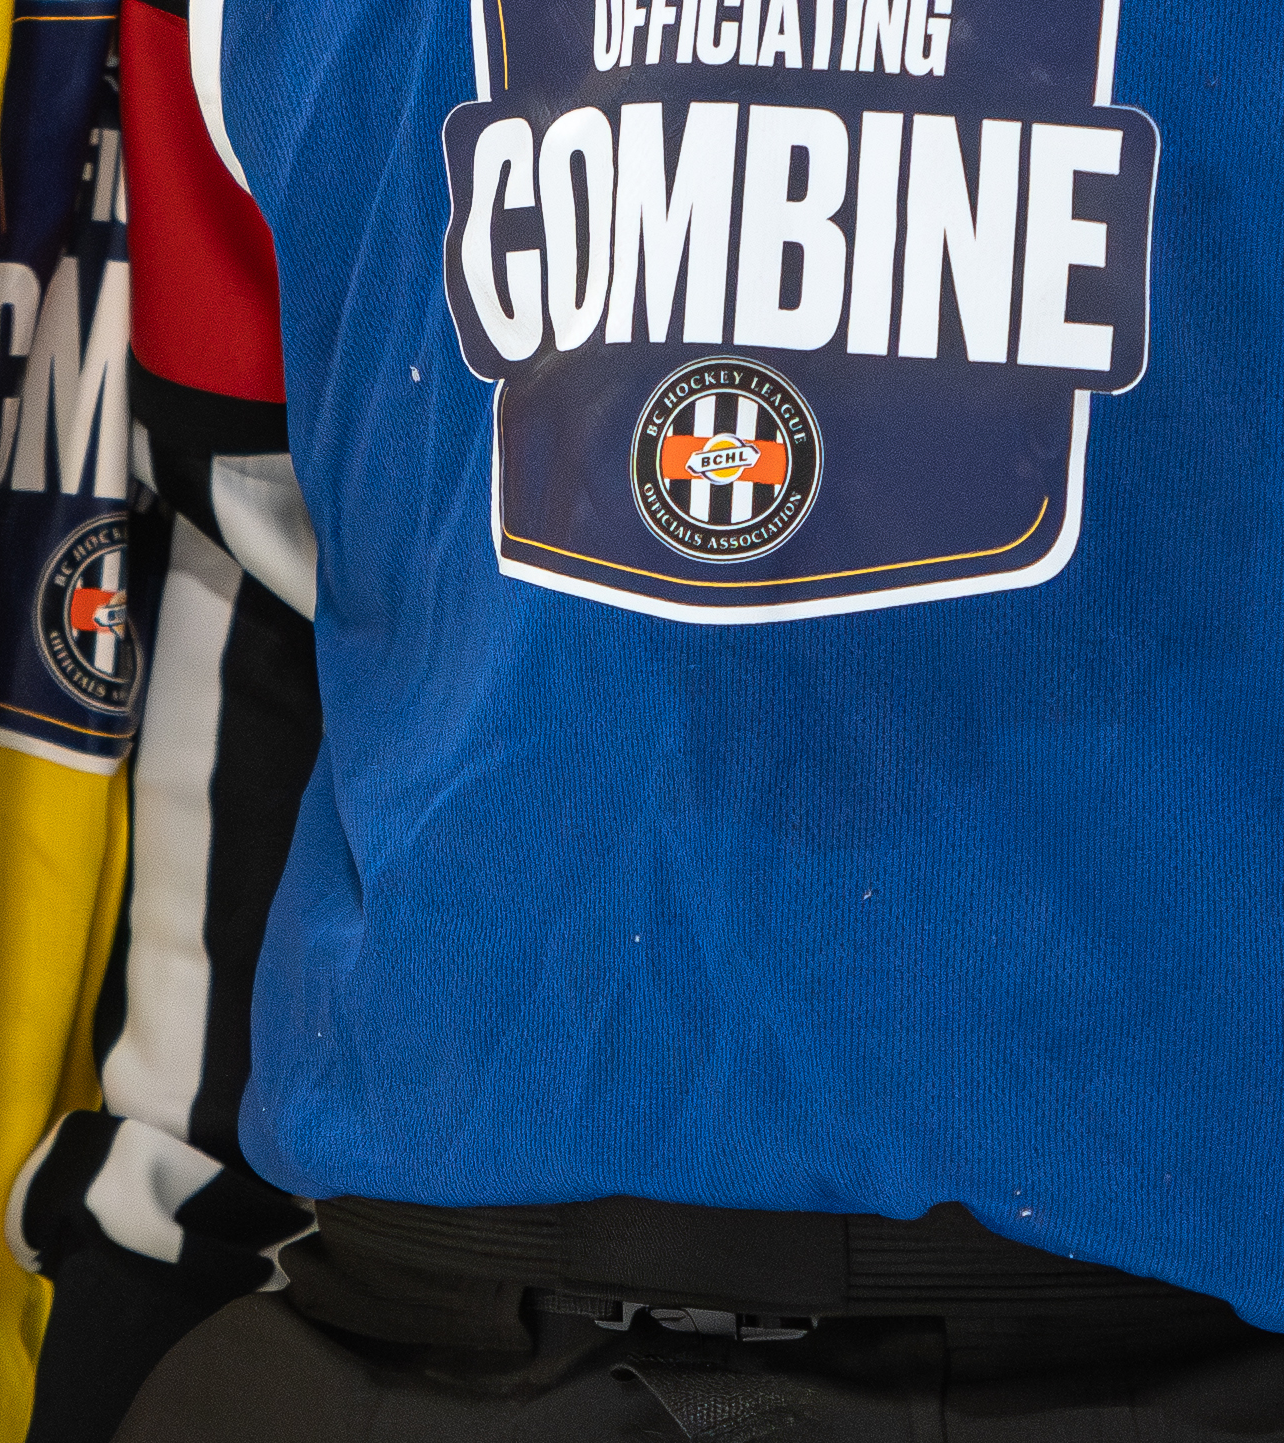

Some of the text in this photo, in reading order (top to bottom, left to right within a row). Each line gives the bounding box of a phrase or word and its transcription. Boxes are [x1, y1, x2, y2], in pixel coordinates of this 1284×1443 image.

[461, 102, 1124, 371] COMBINE
[646, 370, 808, 445] BC HOCKEY LEAGUE
[701, 450, 748, 468] BCHL
[643, 482, 802, 549] OFFICIALS ASSOCIATION
